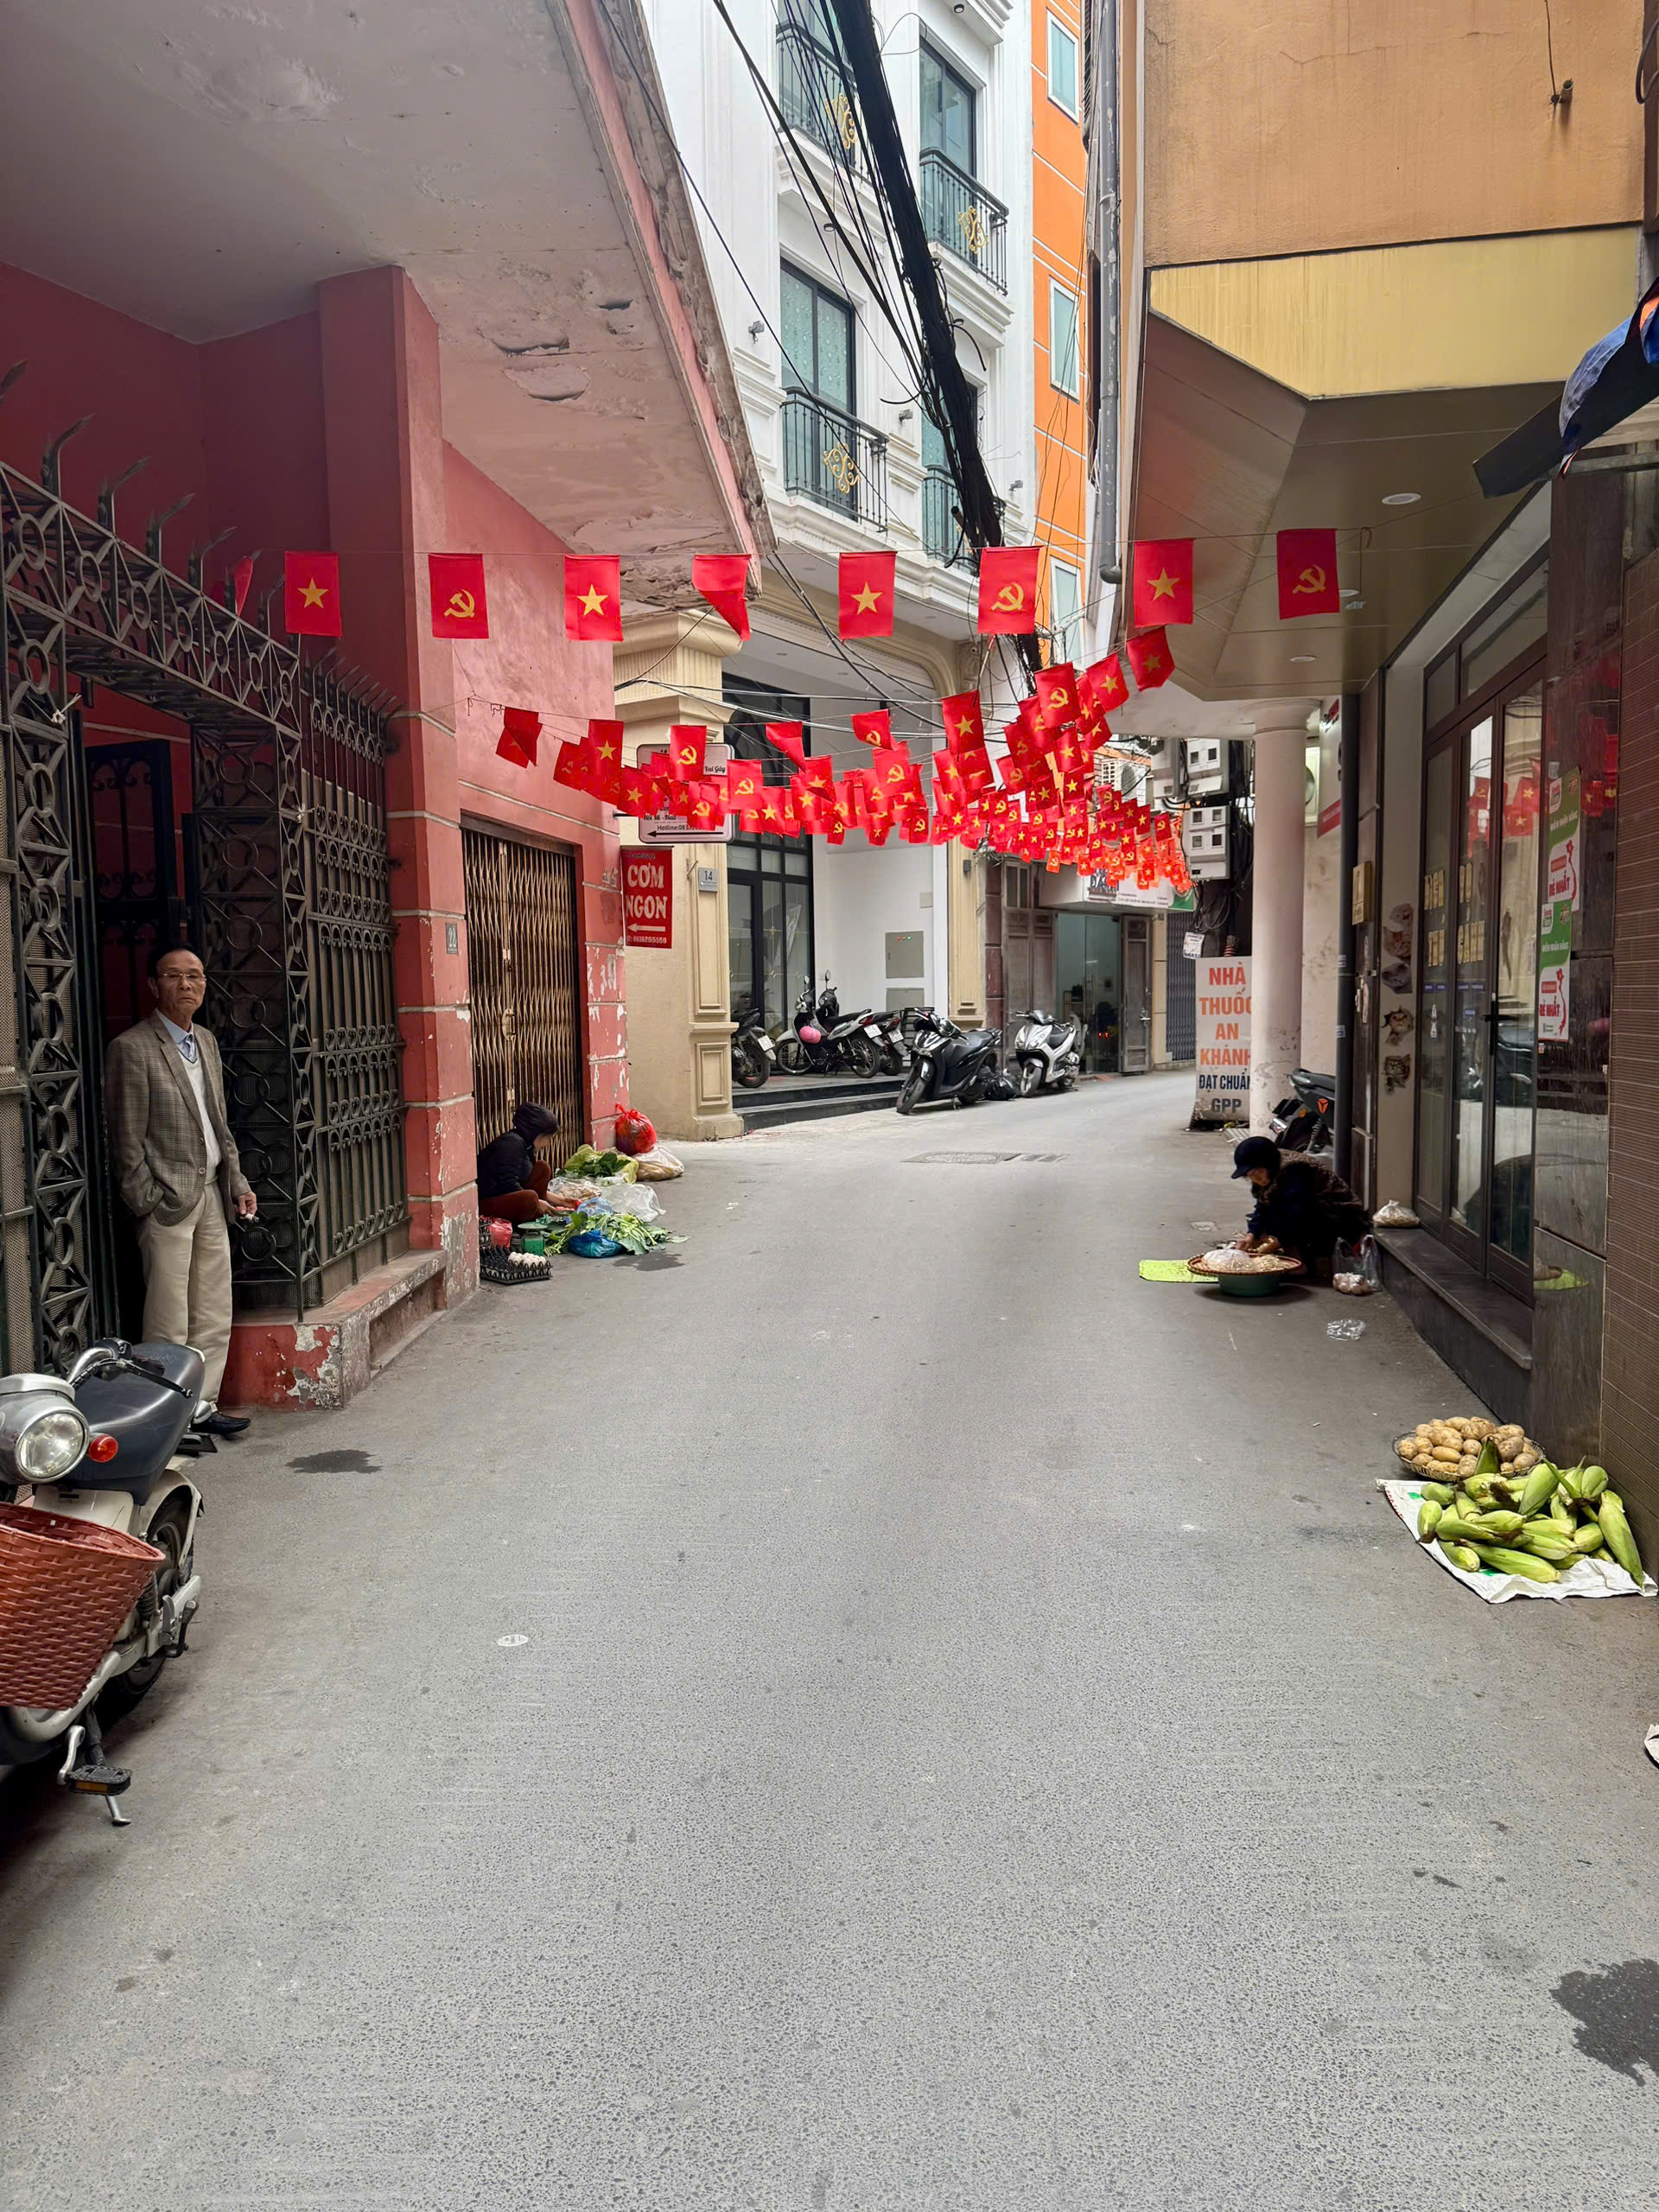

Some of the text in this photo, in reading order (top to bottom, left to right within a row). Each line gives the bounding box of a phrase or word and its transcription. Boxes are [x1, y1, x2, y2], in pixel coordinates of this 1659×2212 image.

[627, 862, 664, 888] CƠM
[704, 870, 713, 881] 14
[626, 894, 668, 919] NGON
[1209, 961, 1246, 986] NHÀ
[1215, 1022, 1239, 1040] AN
[1198, 1074, 1218, 1092] ĐẠT
[1211, 1098, 1242, 1114] GPP
